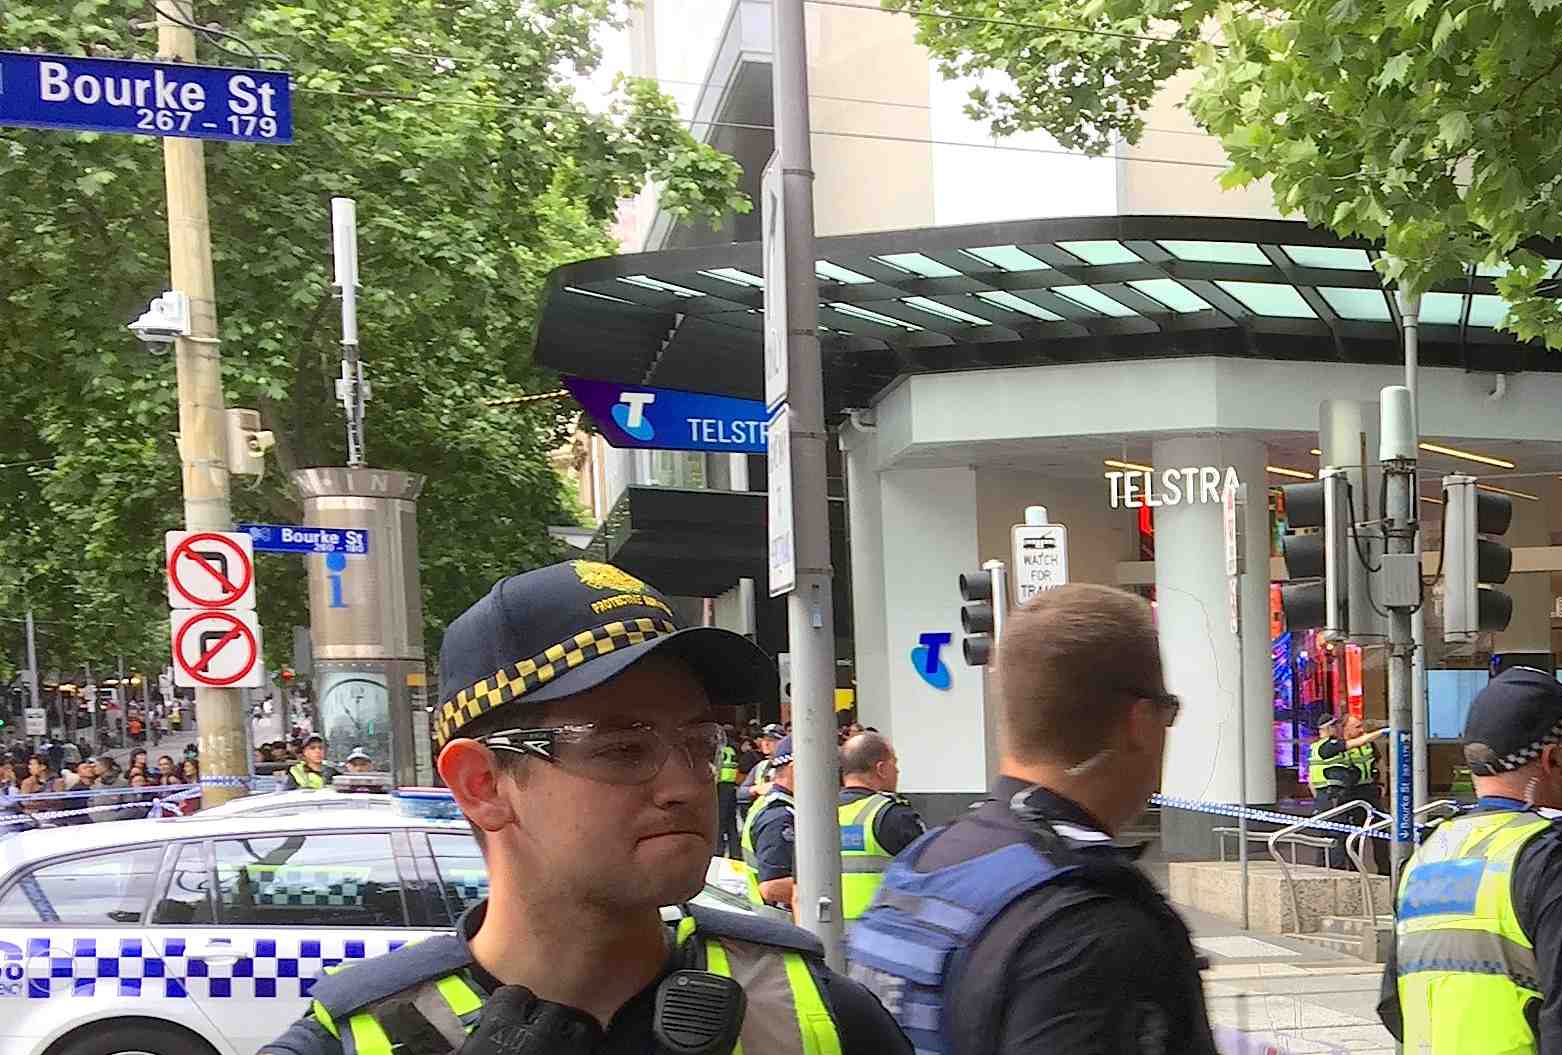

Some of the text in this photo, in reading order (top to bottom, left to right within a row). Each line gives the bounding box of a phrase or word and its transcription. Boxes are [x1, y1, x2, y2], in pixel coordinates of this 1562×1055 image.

[39, 61, 276, 117] Bourke St
[136, 108, 193, 131] 267
[227, 115, 278, 137] 179
[687, 418, 769, 444] TELSTR
[1104, 466, 1239, 509] TELSTRA
[281, 528, 364, 546] Bourke St
[1023, 554, 1058, 566] WATCH
[1031, 570, 1052, 581] FOR
[1400, 795, 1410, 829] Bourke
